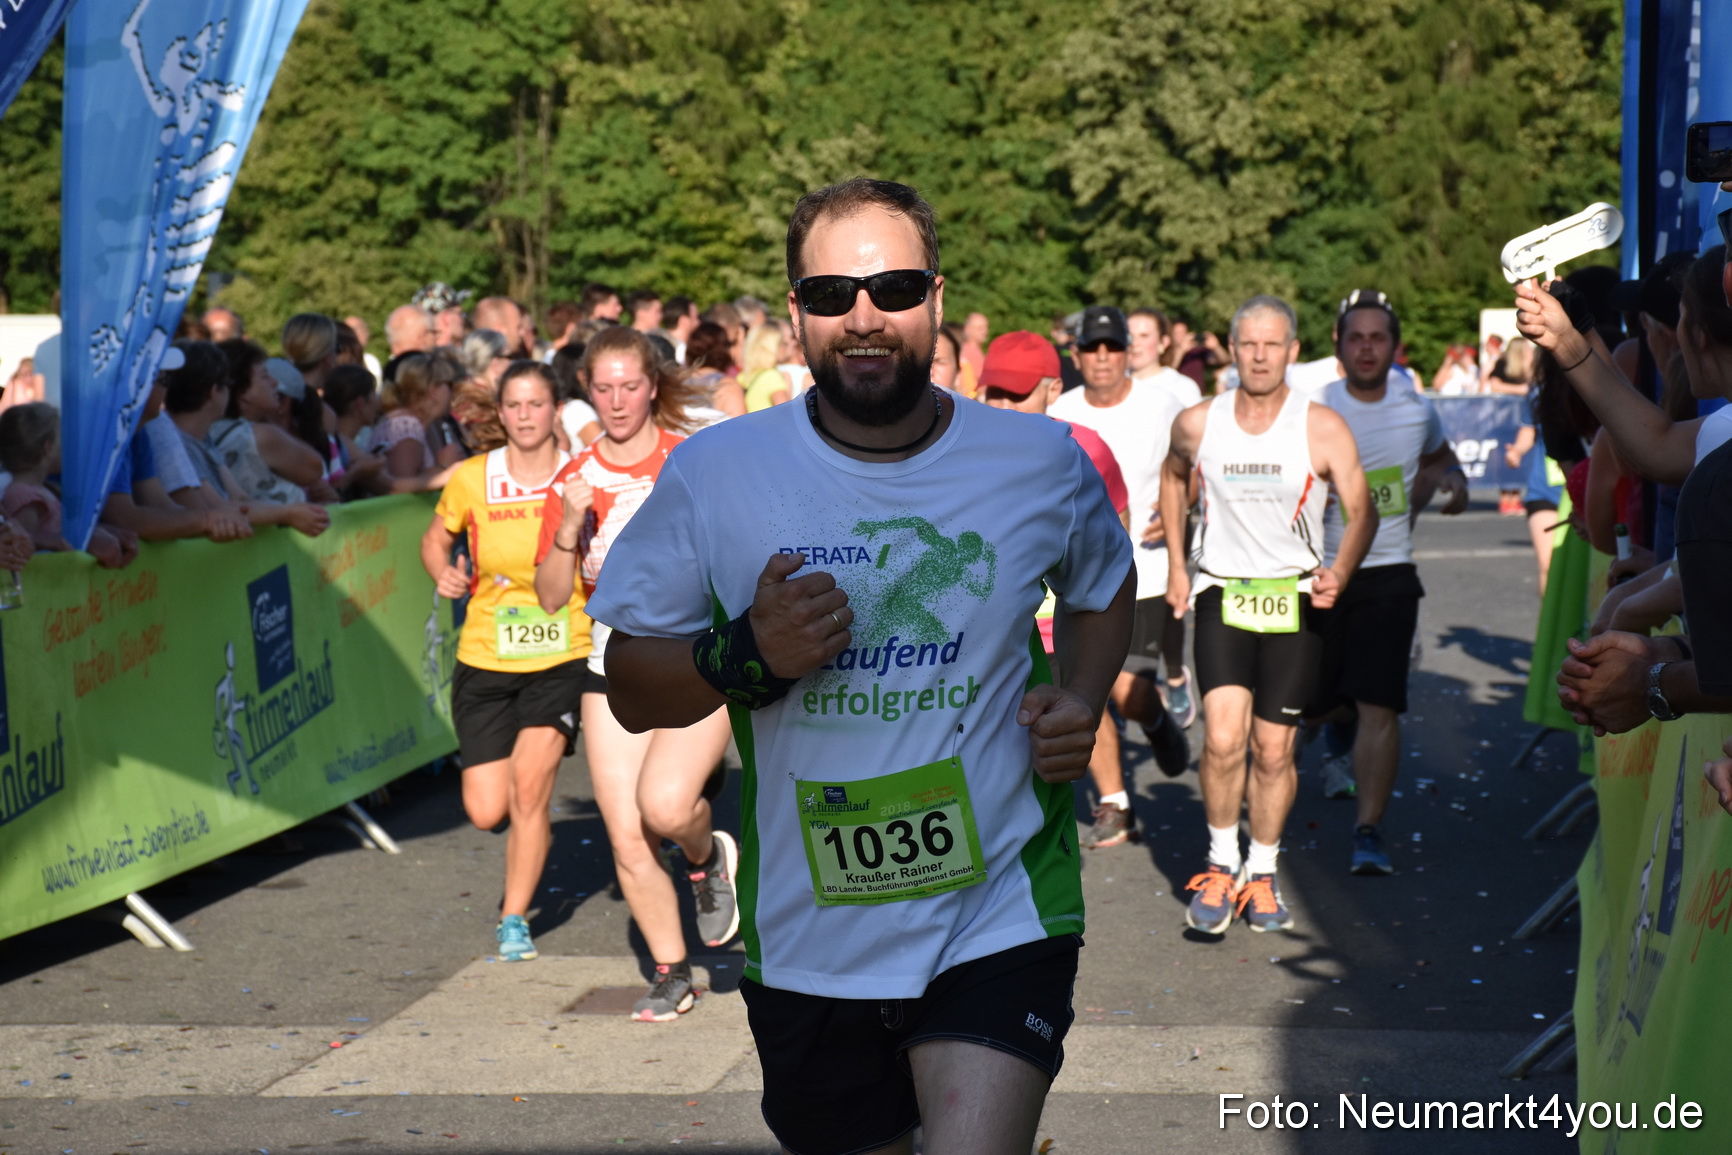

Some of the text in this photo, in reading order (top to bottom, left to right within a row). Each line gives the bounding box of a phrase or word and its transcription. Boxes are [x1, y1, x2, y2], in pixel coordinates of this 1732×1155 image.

[1223, 463, 1282, 475] HUBER
[1368, 485, 1391, 505] 99
[488, 507, 527, 522] MAX
[779, 546, 871, 566] ERATA
[1233, 594, 1289, 615] 2106
[504, 623, 559, 643] 1296
[820, 632, 964, 676] aufend
[245, 640, 334, 757] firmenlauf
[803, 676, 982, 721] erfolgreich
[0, 712, 64, 820] nlauf
[817, 799, 911, 816] firmenlauf 2018
[824, 811, 953, 870] 1036
[822, 885, 837, 893] LBD
[839, 885, 865, 894] Landw.
[866, 873, 947, 892] Buchführungsdienst
[949, 864, 974, 878] GmbH
[846, 861, 943, 884] Kraußer Rainer
[1026, 1012, 1054, 1038] BOSS
